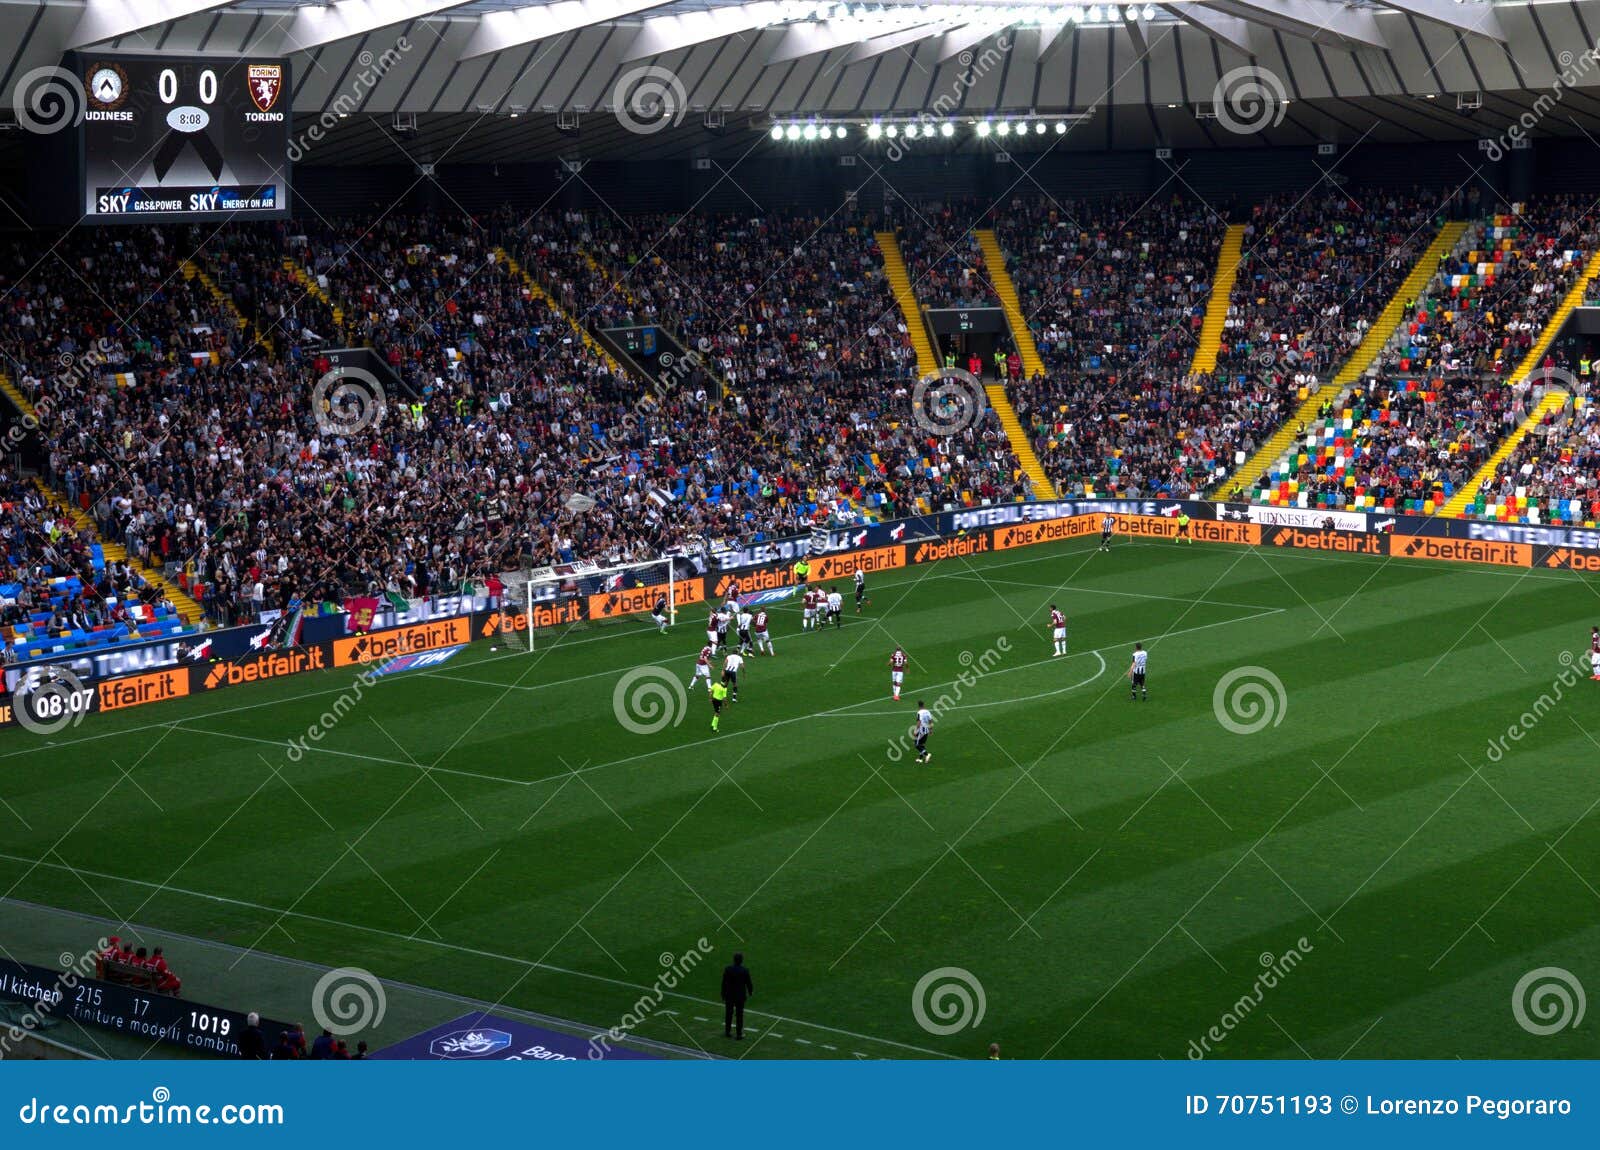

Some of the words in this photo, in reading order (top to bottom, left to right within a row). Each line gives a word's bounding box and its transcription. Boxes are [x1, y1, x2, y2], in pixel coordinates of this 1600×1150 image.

[251, 69, 277, 77] TORINO
[159, 69, 178, 104] 0
[199, 70, 218, 104] 0
[85, 111, 133, 121] UDINESE
[179, 113, 201, 125] 8:08
[245, 112, 284, 122] TORINO
[100, 195, 129, 213] SKY
[134, 200, 183, 211] GAS&POWER
[189, 193, 218, 211] SKY
[222, 199, 249, 209] ENERGY
[1046, 516, 1097, 539] betfair.it
[1258, 511, 1308, 526] UDINESE
[929, 533, 988, 560] betfair.it
[1293, 528, 1381, 554] betfair.it
[1426, 539, 1518, 564] betfair.it
[833, 549, 897, 576] betfair.it
[735, 563, 798, 593] betfair.i
[620, 583, 695, 613] betfar.it
[370, 622, 459, 658] betfair.it
[227, 646, 324, 685] betfair.it
[36, 688, 95, 719] 08:07
[11, 975, 60, 1004] kitchen
[75, 984, 103, 1006] 215
[133, 998, 150, 1017] 17
[74, 1003, 123, 1029] finiture
[130, 1015, 181, 1042] modelli
[187, 1031, 242, 1056] combin
[190, 1011, 231, 1037] 1019
[520, 1046, 577, 1060] Ban
